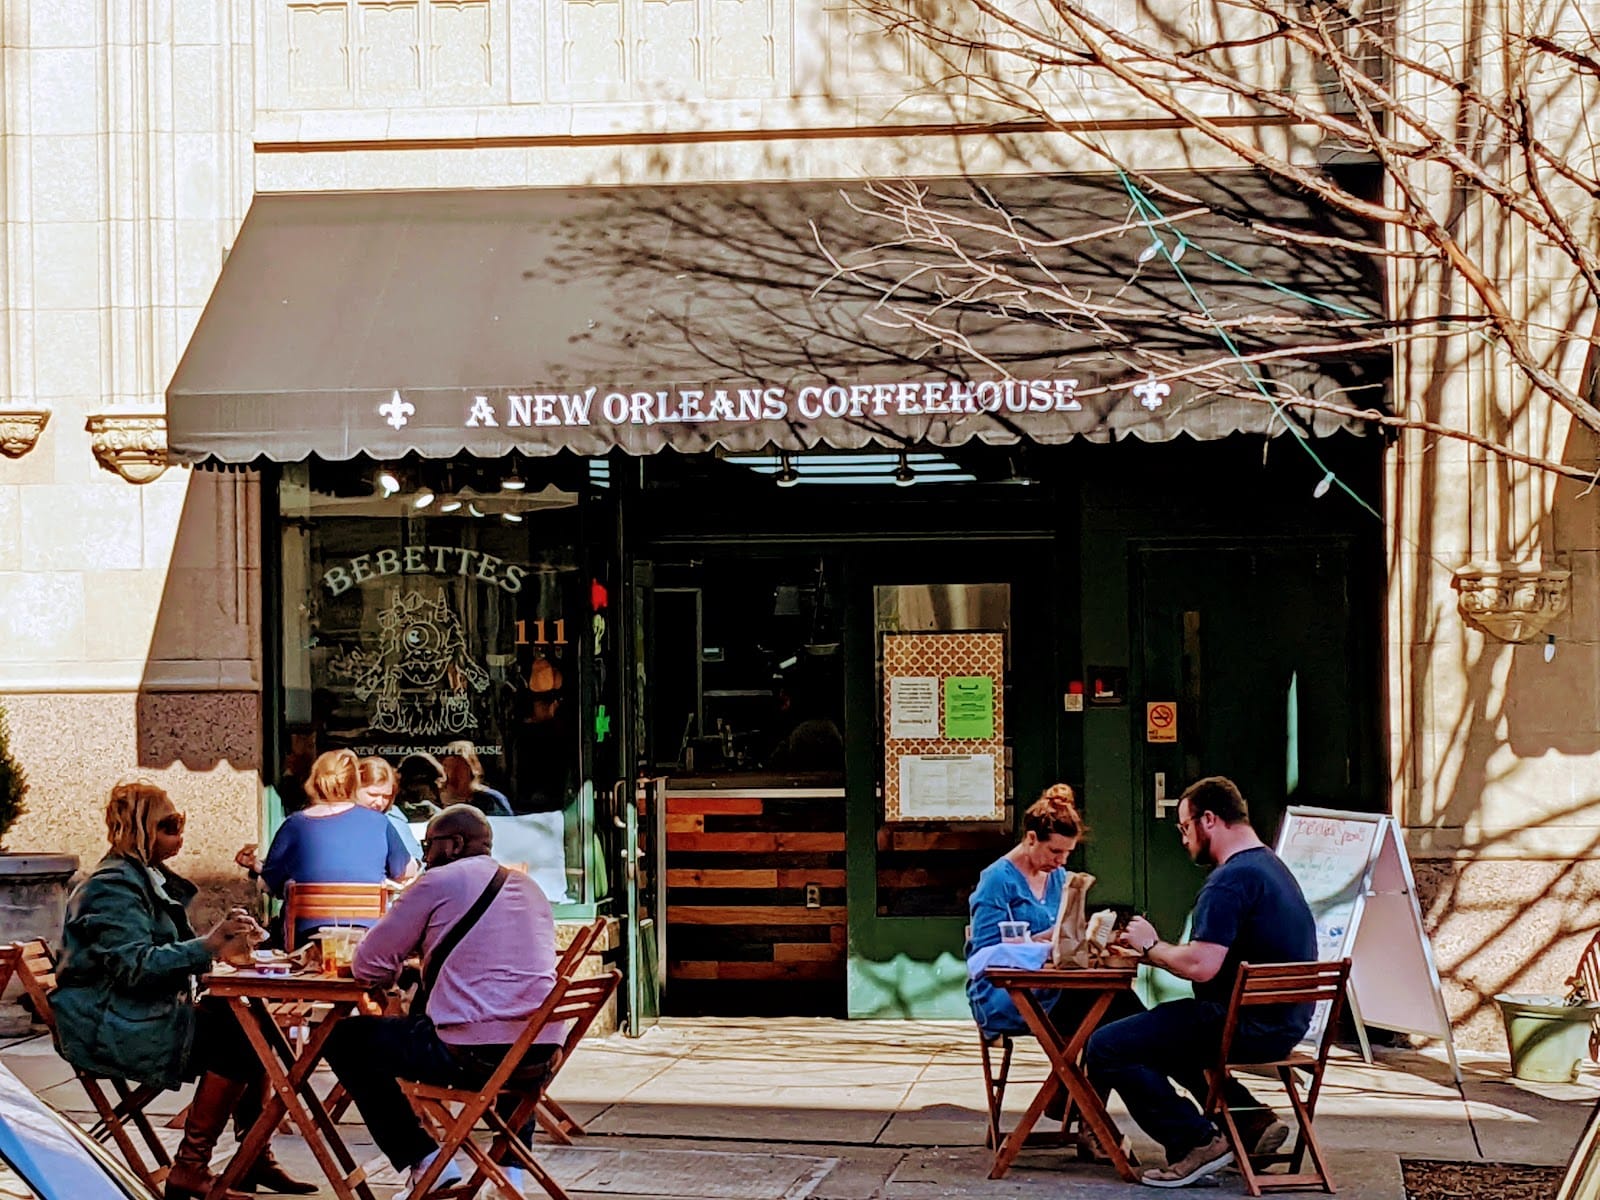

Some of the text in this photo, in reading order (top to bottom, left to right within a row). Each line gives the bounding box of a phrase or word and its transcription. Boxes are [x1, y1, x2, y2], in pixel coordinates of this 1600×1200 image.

[465, 379, 1082, 427] A NEW ORLEANS COFFEEHOUSE
[323, 545, 527, 597] BEBETTES
[514, 618, 569, 645] 111
